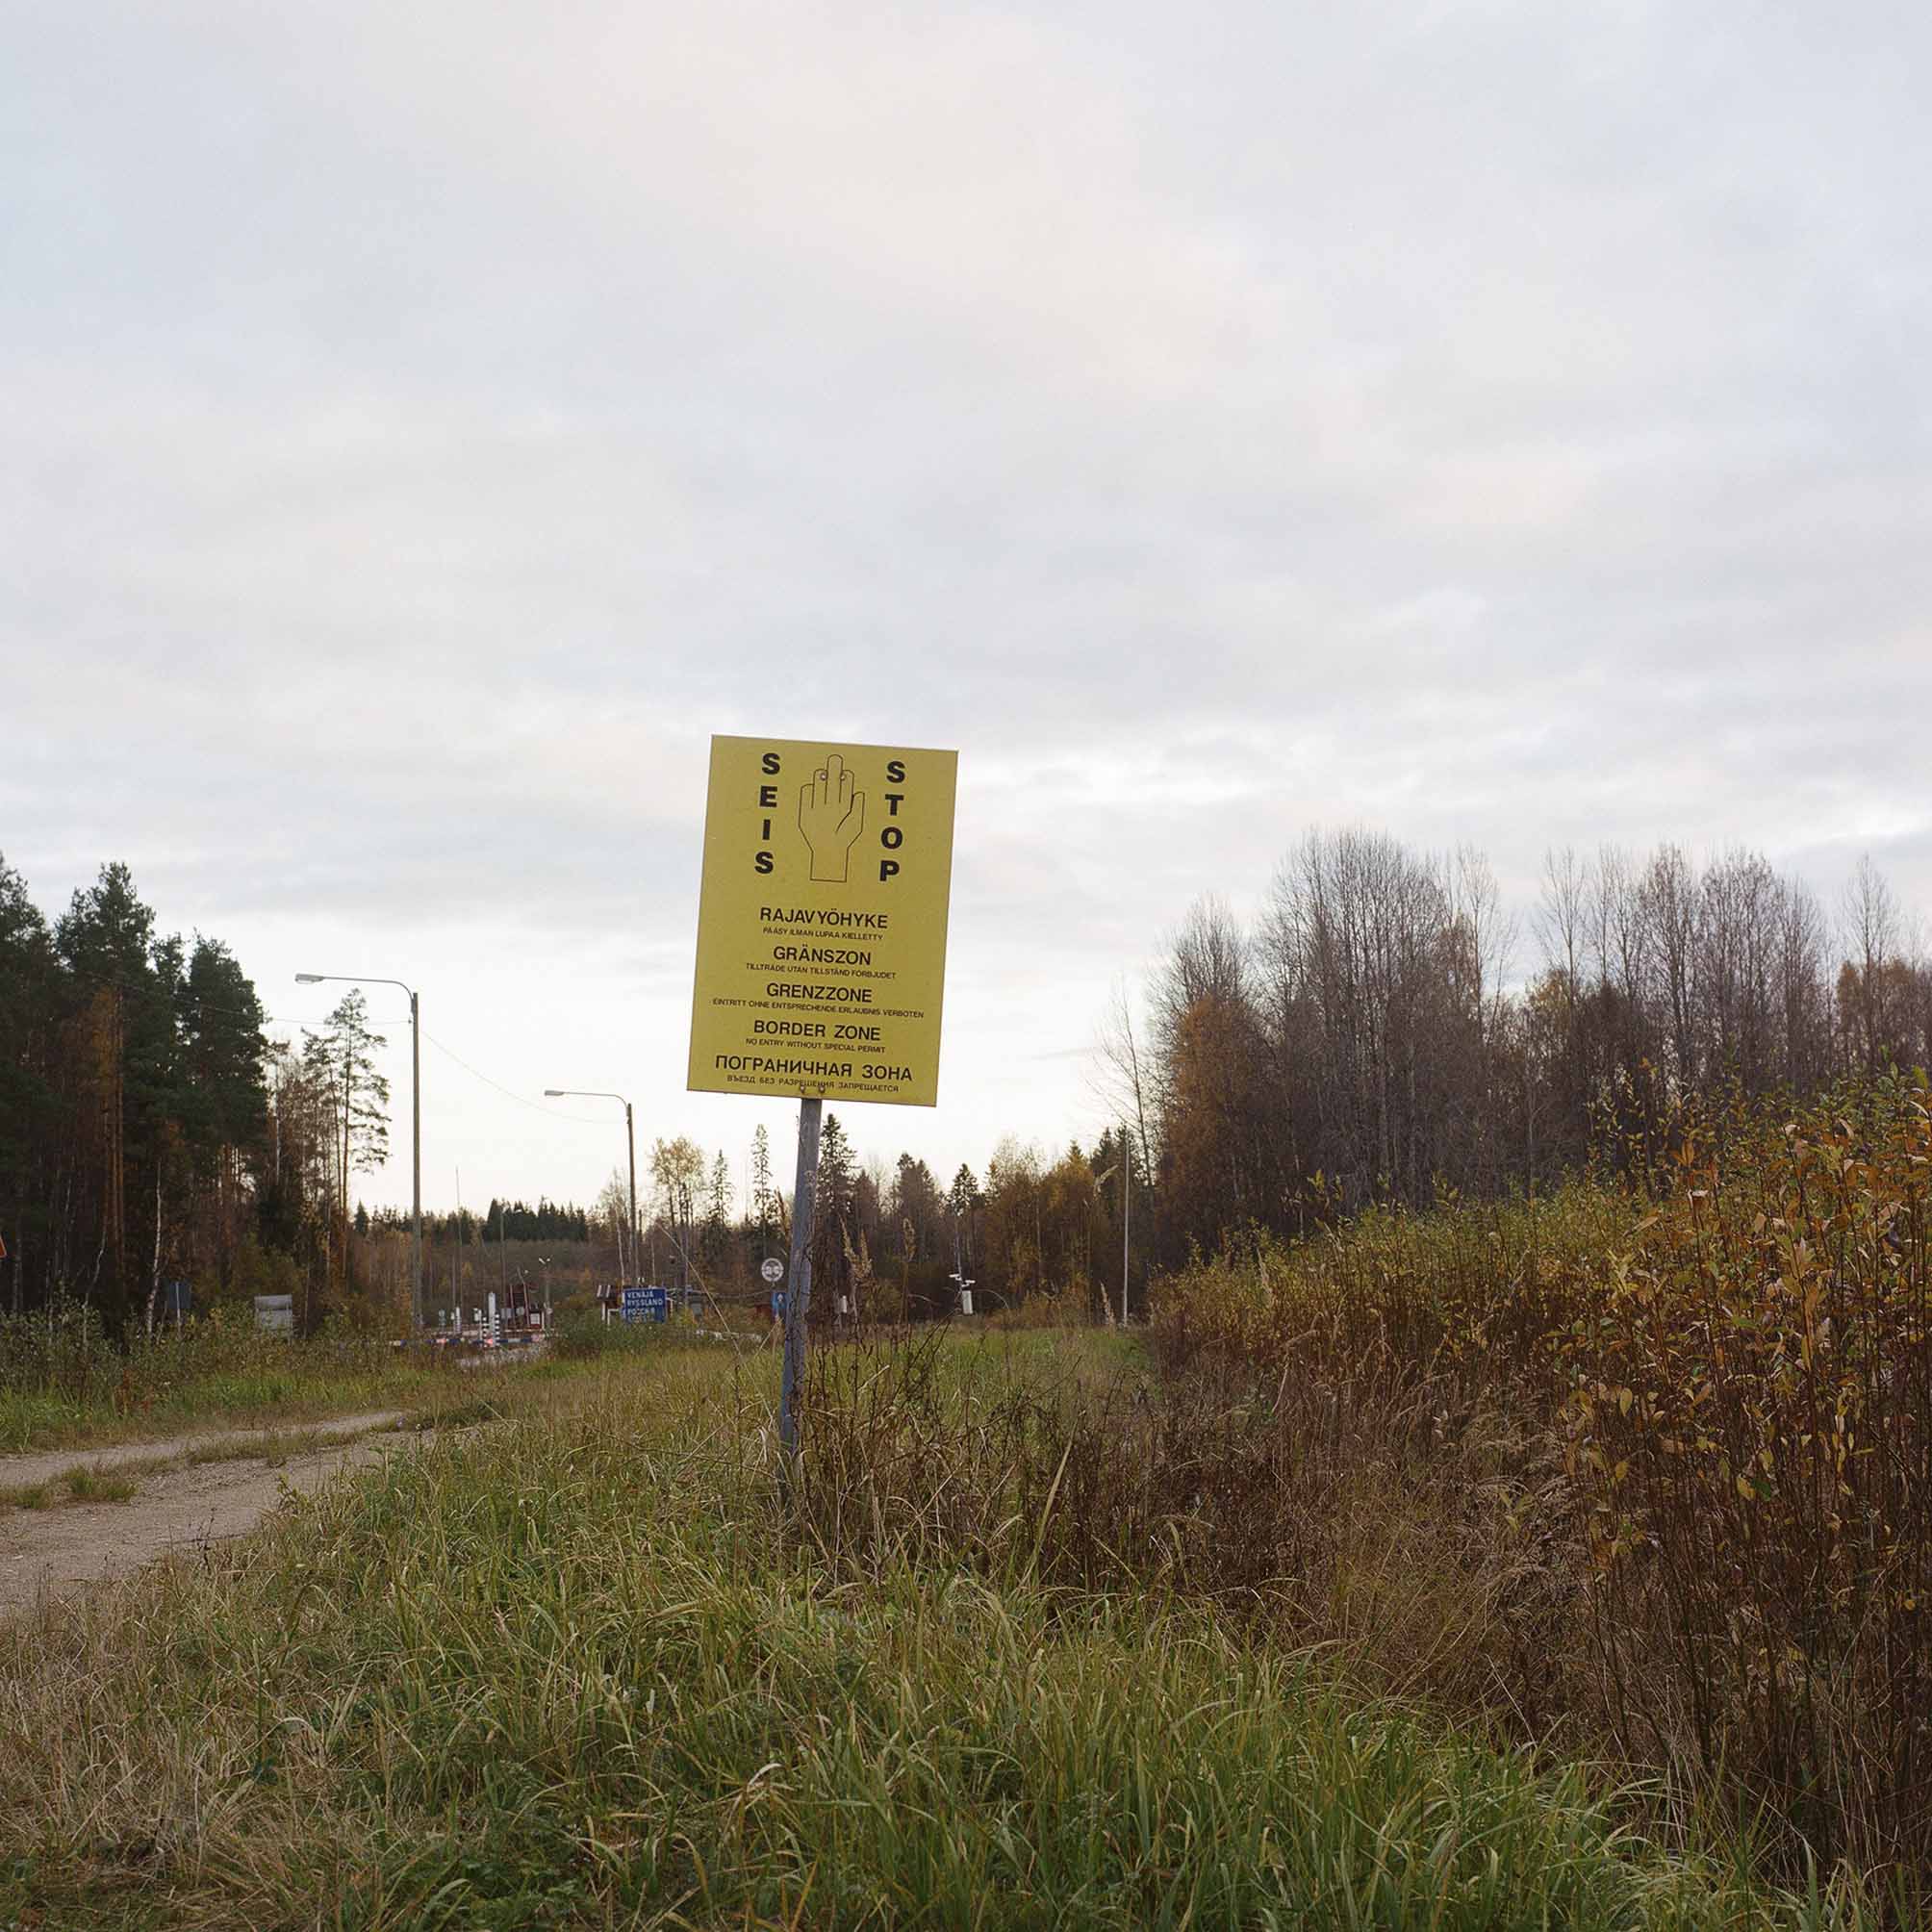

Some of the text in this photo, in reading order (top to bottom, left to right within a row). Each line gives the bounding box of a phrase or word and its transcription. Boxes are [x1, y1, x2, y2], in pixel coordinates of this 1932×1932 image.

[754, 752, 780, 875] SEIS
[879, 761, 905, 882] STOP
[760, 906, 888, 929] RAJAVYÖHYKE
[842, 931, 883, 940] KIELLETTY
[774, 944, 871, 966] GRÄNSZON
[767, 982, 872, 1004] GRENZZONE
[713, 998, 924, 1019] EINTRITT OHNE ENTSPRECHENDE ERLAUBNIS VERBOTEN
[754, 1020, 881, 1041] BORDER ZONE
[746, 1037, 885, 1054] NO ENTRY WITHOUT SPECIAL PERMIT
[716, 1055, 912, 1081] ПОГРАНИЧНАЯ ЗОНА
